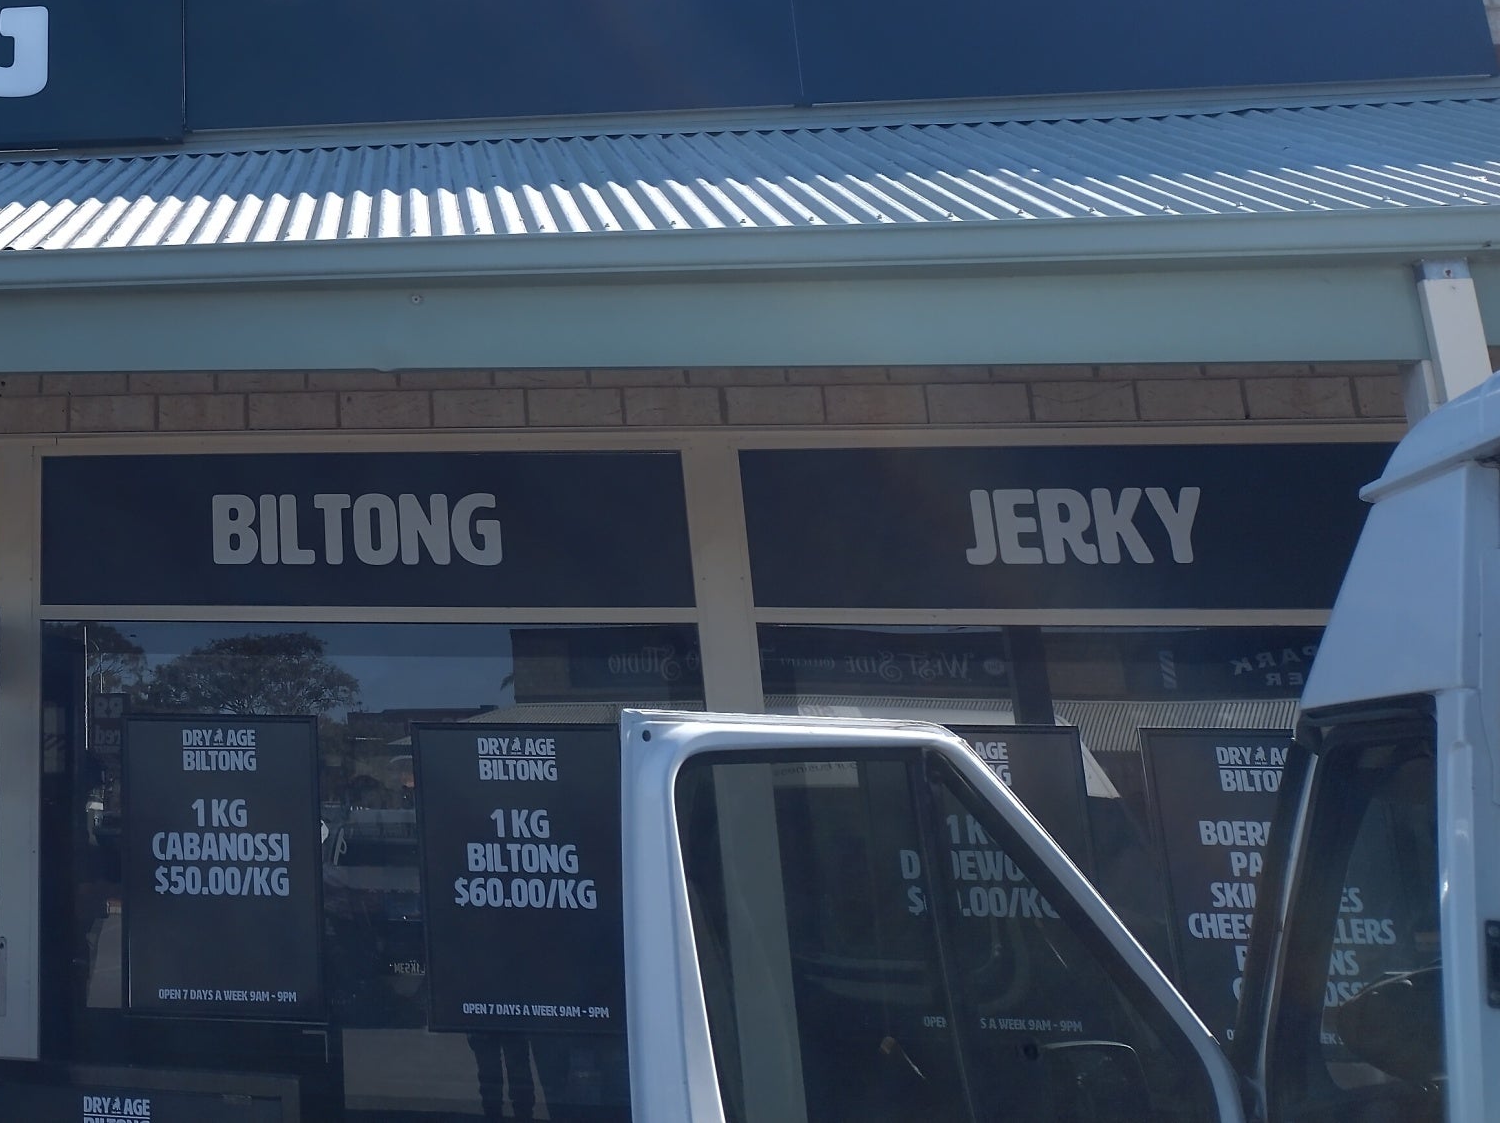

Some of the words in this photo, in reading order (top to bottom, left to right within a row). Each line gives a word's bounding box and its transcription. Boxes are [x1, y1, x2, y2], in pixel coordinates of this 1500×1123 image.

[212, 493, 502, 566] BILTONG
[966, 487, 1200, 565] JERKY
[182, 729, 213, 746] DRY
[226, 729, 256, 746] AGE
[477, 738, 511, 755] DRY
[524, 738, 556, 756] AGE
[183, 750, 257, 771] BILTONG
[1216, 747, 1252, 765] DRY
[479, 759, 558, 781] BILTONG
[1220, 770, 1282, 792] BILTO
[191, 799, 205, 827] 1
[211, 799, 248, 828] KG
[490, 809, 505, 838] 1
[511, 809, 550, 839] KG
[946, 815, 961, 844] 1
[151, 832, 291, 862] CABANOSSI
[467, 843, 579, 874] BILTONG
[154, 865, 290, 897] $50.00/KG
[454, 877, 598, 910] $60.00/KG
[158, 988, 181, 1000] OPEN
[182, 989, 189, 1000] 7
[190, 989, 214, 1001] DAYS
[214, 990, 222, 1001] A
[223, 990, 248, 1002] WEEK
[249, 990, 270, 1002] 9AM
[277, 991, 297, 1003] 9PM
[463, 1003, 487, 1015] OPEN
[488, 1003, 495, 1015] 7
[496, 1004, 522, 1016] DAYS
[522, 1005, 530, 1016] A
[531, 1005, 558, 1017] WEEK
[559, 1005, 581, 1017] 9AM
[588, 1006, 610, 1018] 9PM
[83, 1096, 111, 1114] DRY
[123, 1098, 151, 1116] AGE
